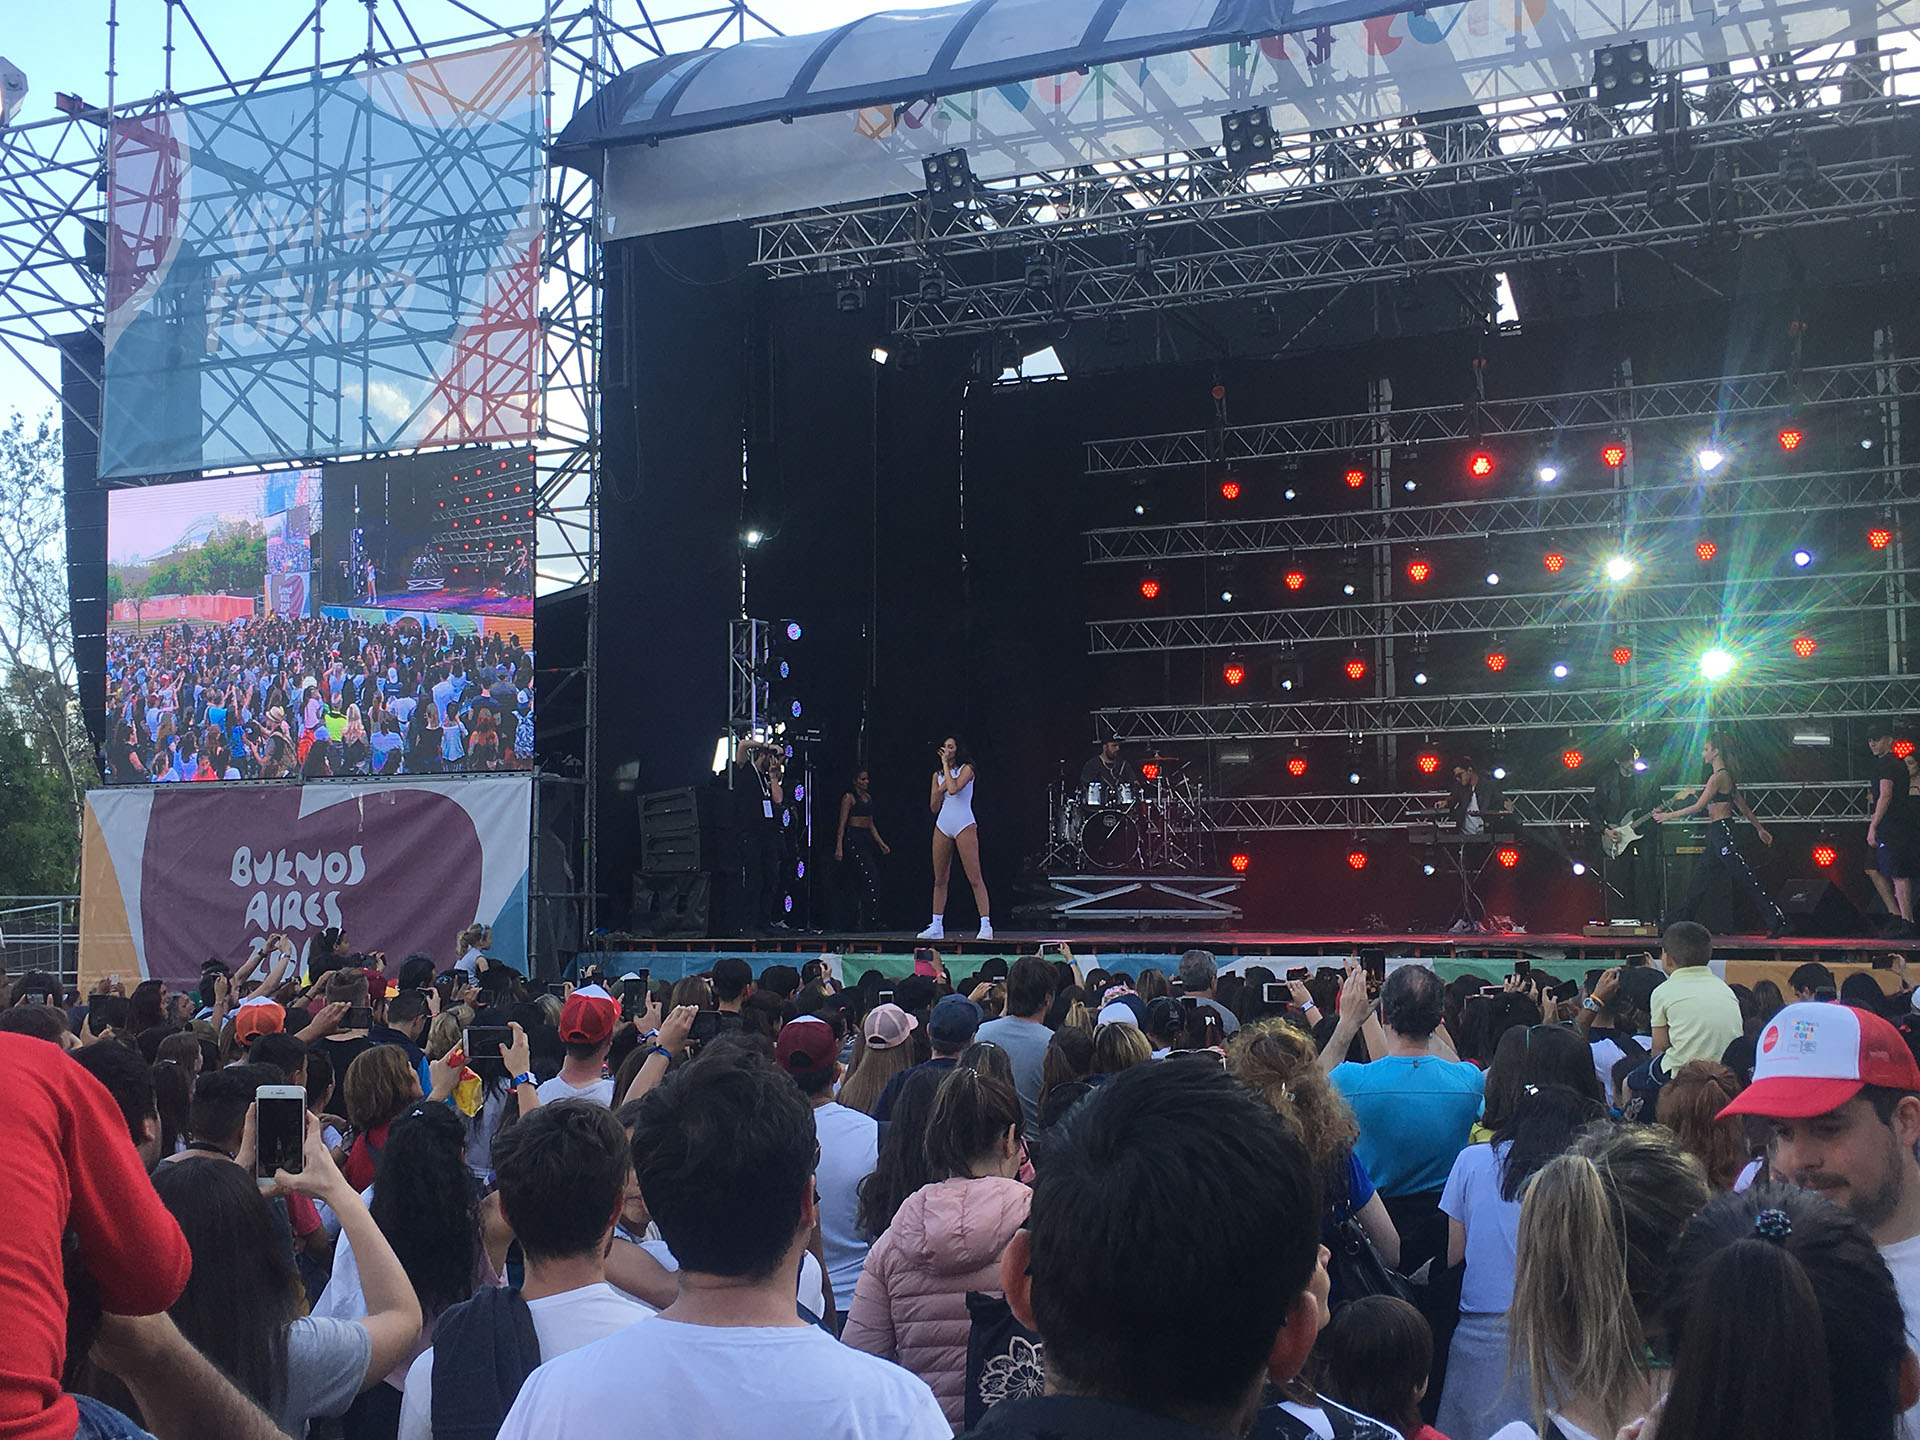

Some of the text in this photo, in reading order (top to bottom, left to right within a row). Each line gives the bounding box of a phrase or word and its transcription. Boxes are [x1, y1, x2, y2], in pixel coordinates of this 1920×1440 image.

[343, 173, 393, 241] el
[229, 845, 366, 887] BUENOS
[244, 890, 343, 932] AIRES
[246, 936, 312, 982] 201
